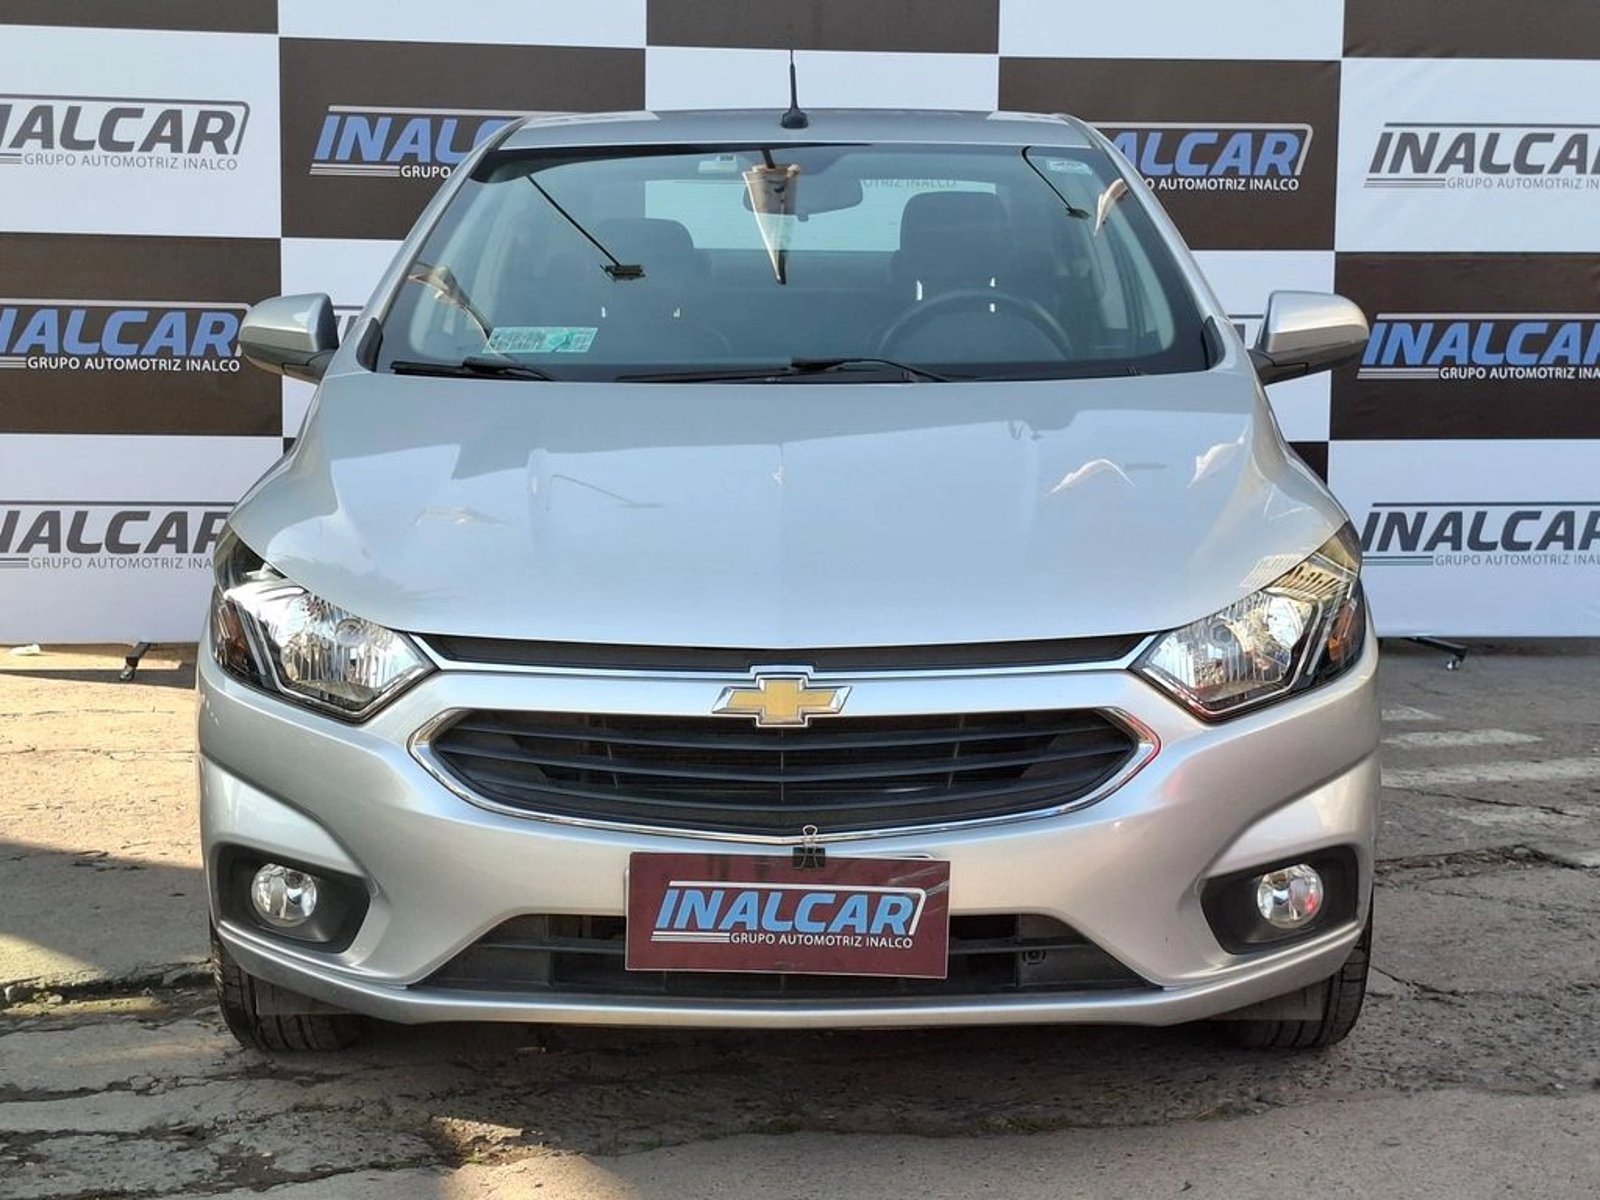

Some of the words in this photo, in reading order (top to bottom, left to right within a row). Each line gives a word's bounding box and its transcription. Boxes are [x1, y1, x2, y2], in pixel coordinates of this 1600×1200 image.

[0, 104, 236, 155] ALCAR
[314, 114, 509, 164] INAL
[24, 153, 76, 167] GRUPO
[80, 155, 179, 170] AUTOMOTRIZ
[183, 158, 238, 171] INALCO
[1369, 132, 1600, 175] INALCA
[401, 164, 451, 179] GRUPO
[1158, 177, 1246, 191] AUTOMOTRIZ
[1250, 178, 1299, 192] INALCO
[1447, 177, 1492, 190] GRUPO
[1496, 177, 1582, 190] AUTOMOTRIZ
[0, 307, 239, 357] ALCAR
[27, 356, 80, 370] GRUPO
[84, 357, 181, 372] AUTOMOTRIZ
[186, 359, 240, 373] INALCO
[1439, 367, 1486, 380] GRUPO
[1489, 367, 1576, 380] AUTOMOTRIZ
[31, 556, 82, 570] GRUPO
[87, 556, 184, 570] AUTOMOTRIZ
[1435, 554, 1481, 566] GRUPO
[1485, 553, 1570, 566] AUTOMOTRIZ
[655, 889, 914, 936] INALCAR
[730, 932, 775, 945] GRUPO
[779, 934, 862, 948] AUTOMOTRIZ
[866, 937, 913, 949] INALCO
